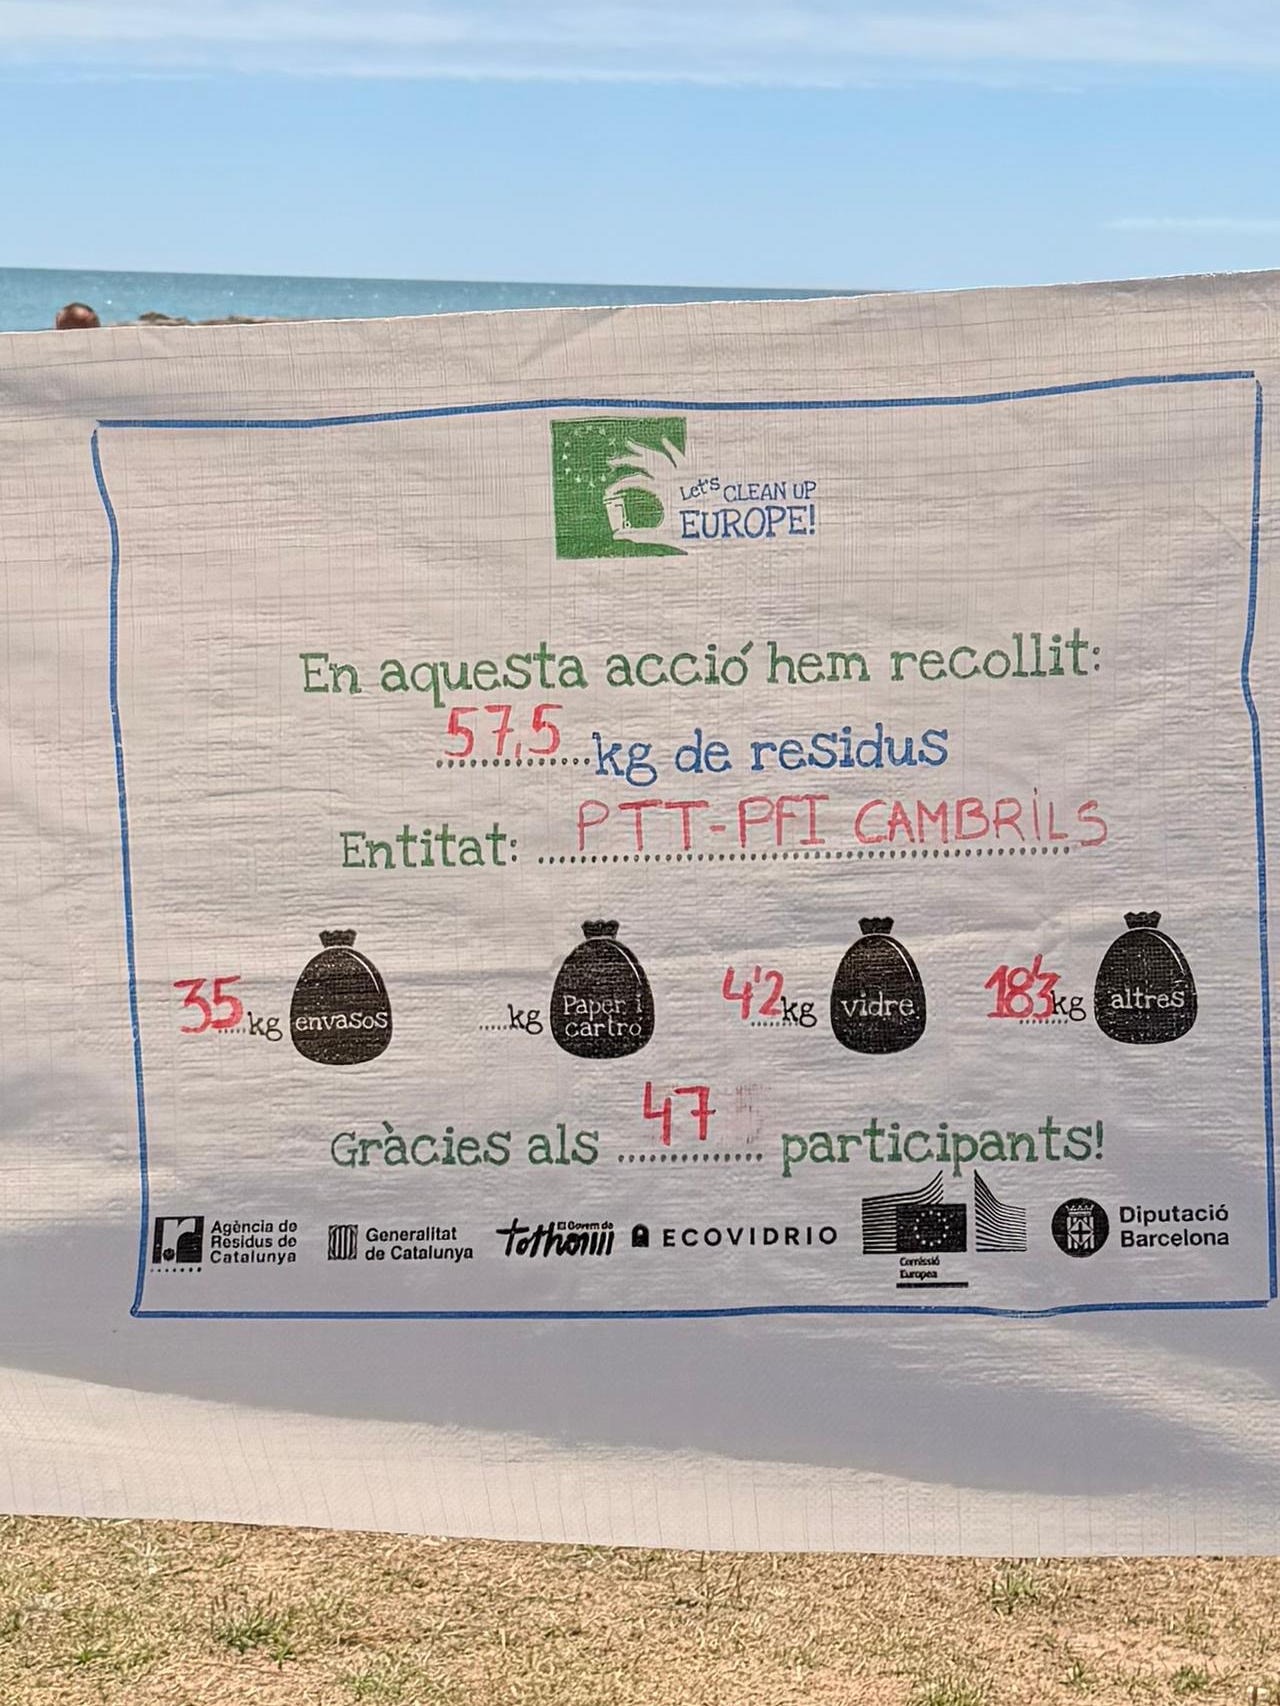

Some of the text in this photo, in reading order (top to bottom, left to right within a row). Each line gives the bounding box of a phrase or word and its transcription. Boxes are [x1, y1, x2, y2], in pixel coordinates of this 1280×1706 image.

[680, 477, 817, 502] Let's CLEAN UP
[680, 504, 816, 539] EUROPE!
[299, 628, 1101, 708] En aquesta acció hem recollit:
[592, 731, 658, 787] kg
[675, 728, 732, 774] de
[750, 723, 949, 772] residus
[340, 823, 518, 870] Entitat:
[173, 975, 284, 1042] 35 kg
[563, 993, 643, 1021] Paper i
[840, 991, 916, 1017] vidre
[1050, 990, 1086, 1021] kg
[1111, 986, 1185, 1009] altres
[295, 1011, 389, 1032] envasos
[507, 1003, 544, 1035] kg
[780, 996, 818, 1028] kg
[330, 1081, 1104, 1178] Gràcies als 47 participants!
[278, 1219, 298, 1233] de
[1119, 1203, 1230, 1224] Diputació
[211, 1234, 297, 1249] Residus de
[365, 1226, 458, 1242] Generalitat
[662, 1226, 839, 1248] ECOVIDRIO
[1119, 1229, 1230, 1248] Barcelona
[210, 1250, 297, 1265] Catalunya
[365, 1245, 474, 1263] de Catalunya
